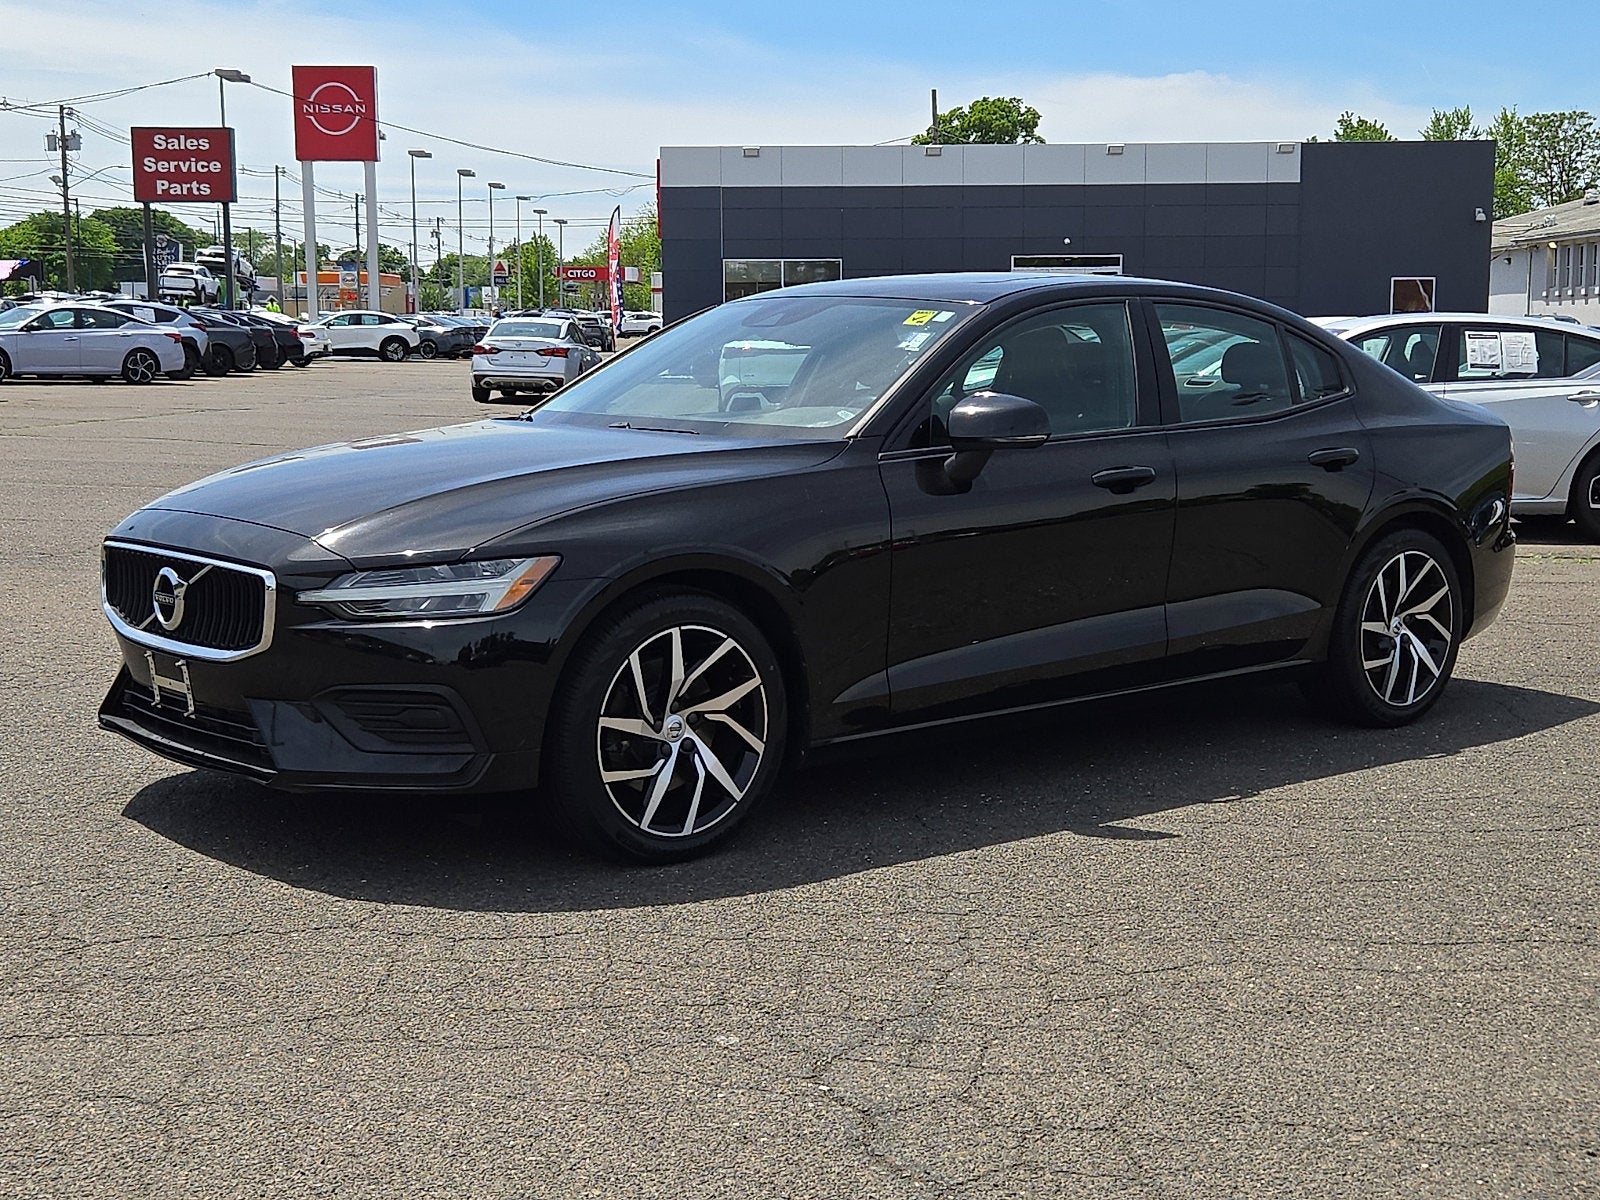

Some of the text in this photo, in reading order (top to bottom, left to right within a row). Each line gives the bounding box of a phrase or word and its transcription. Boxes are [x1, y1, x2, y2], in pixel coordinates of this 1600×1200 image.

[303, 104, 366, 113] NISSAN
[153, 134, 210, 150] Sales
[143, 158, 222, 173] Service
[156, 180, 211, 195] Parts
[567, 269, 596, 278] CITGO
